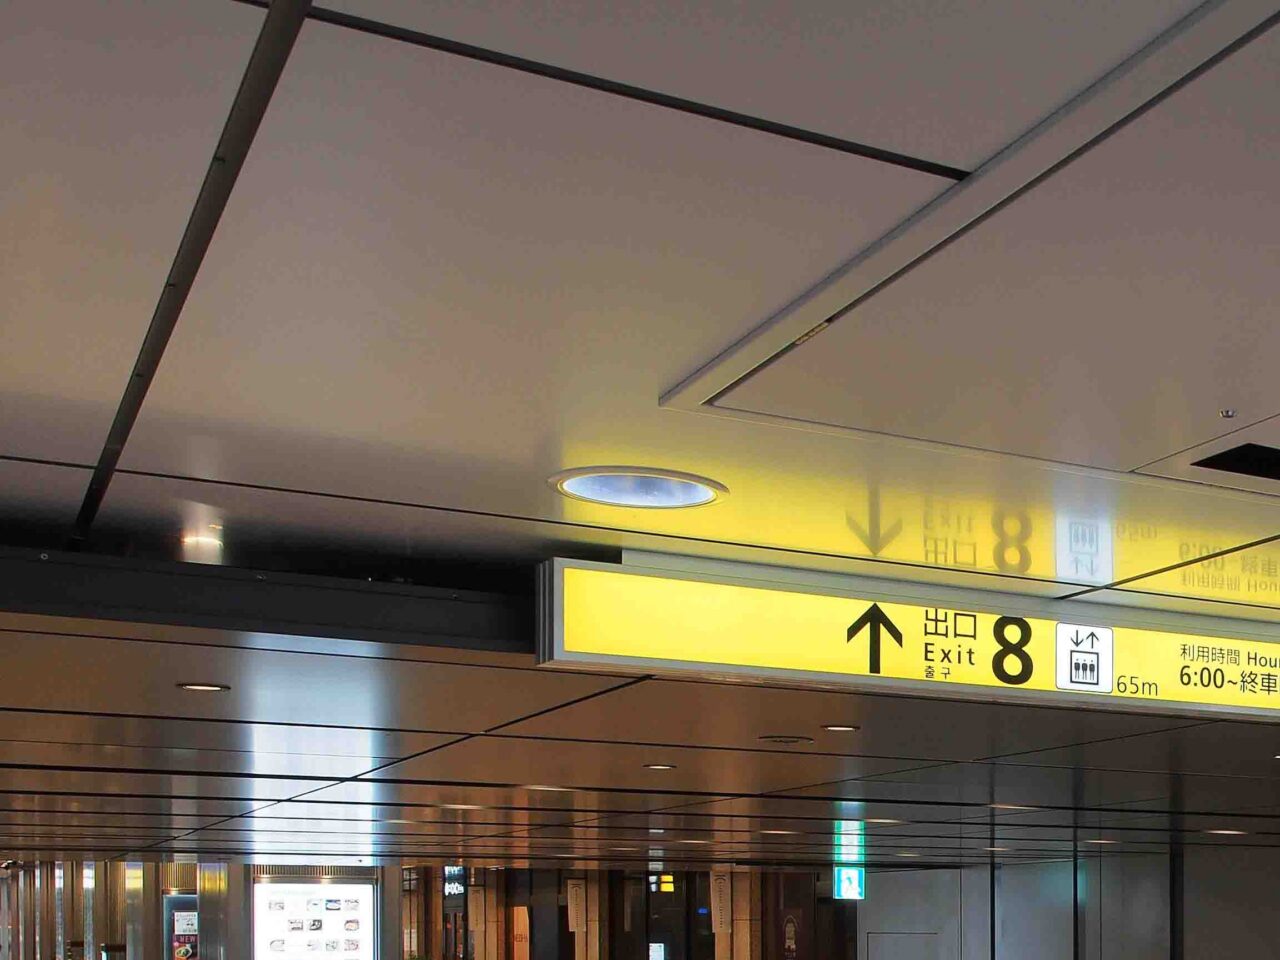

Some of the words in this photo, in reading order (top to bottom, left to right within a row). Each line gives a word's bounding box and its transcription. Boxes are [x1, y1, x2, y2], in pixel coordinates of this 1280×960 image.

[924, 608, 977, 640] 出口
[924, 642, 975, 666] Exit
[992, 615, 1034, 685] 8
[1180, 643, 1241, 666] 利用時間
[1116, 675, 1159, 697] 65m
